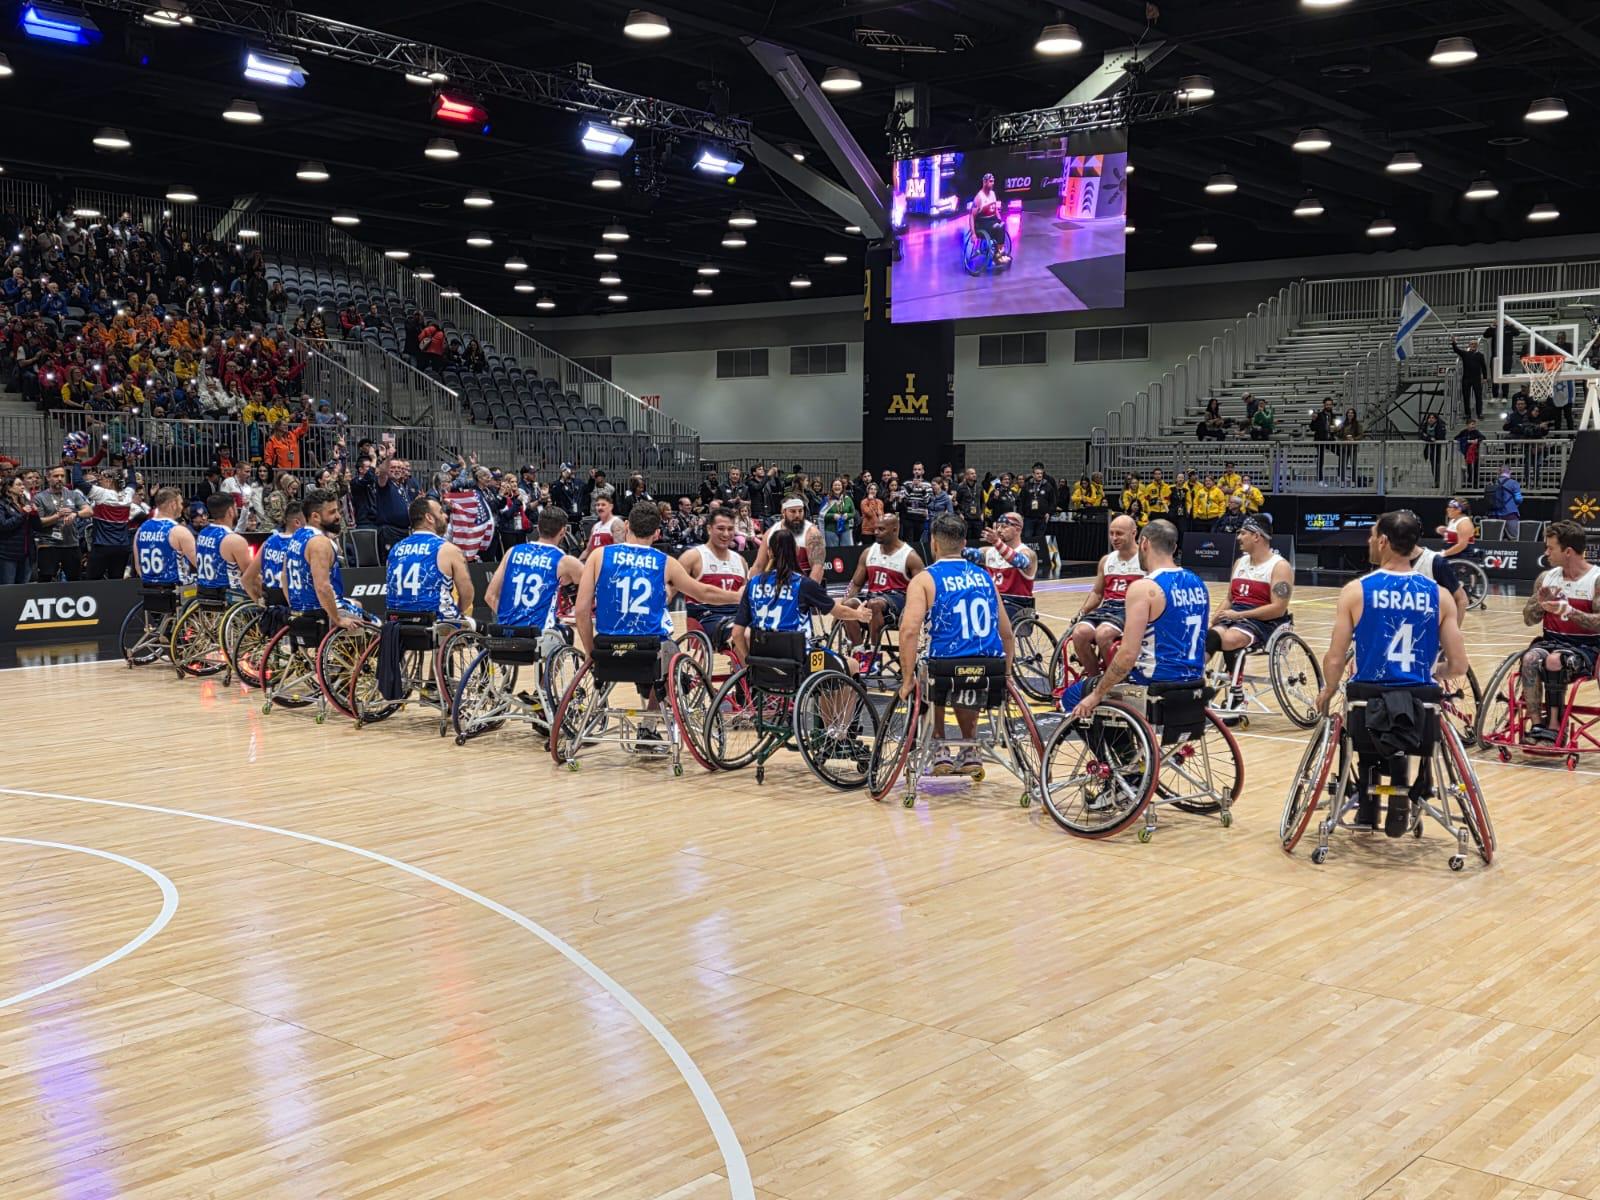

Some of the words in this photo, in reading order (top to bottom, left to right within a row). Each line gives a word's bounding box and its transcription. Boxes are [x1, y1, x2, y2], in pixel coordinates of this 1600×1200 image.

[906, 178, 925, 198] AM
[905, 373, 915, 393] I
[887, 394, 929, 414] AM
[139, 530, 166, 542] ISRAEL
[196, 534, 216, 549] SRAEL
[264, 548, 287, 564] ISRAE
[395, 543, 431, 557] ISRAEL
[140, 547, 164, 574] 56
[196, 552, 215, 581] 26
[511, 551, 553, 570] ISRAEL
[613, 552, 659, 570] ISRAEL
[1479, 555, 1518, 569] OVE
[287, 558, 302, 590] 15
[393, 562, 421, 596] 14
[873, 571, 887, 586] 16
[942, 573, 991, 592] ISRAEL
[350, 583, 388, 597] BOE
[511, 572, 543, 608] 13
[721, 578, 735, 592] 17
[751, 583, 794, 601] ISRAEL
[1112, 578, 1128, 592] 12
[616, 576, 651, 615] 12
[1171, 587, 1208, 608] ISRAEL
[1372, 590, 1434, 613] ISRAEL
[18, 595, 97, 622] ATCO
[953, 598, 992, 640] 10
[1186, 615, 1203, 660] 7
[1387, 624, 1416, 672] 4
[811, 653, 824, 668] 89
[957, 690, 977, 706] 10
